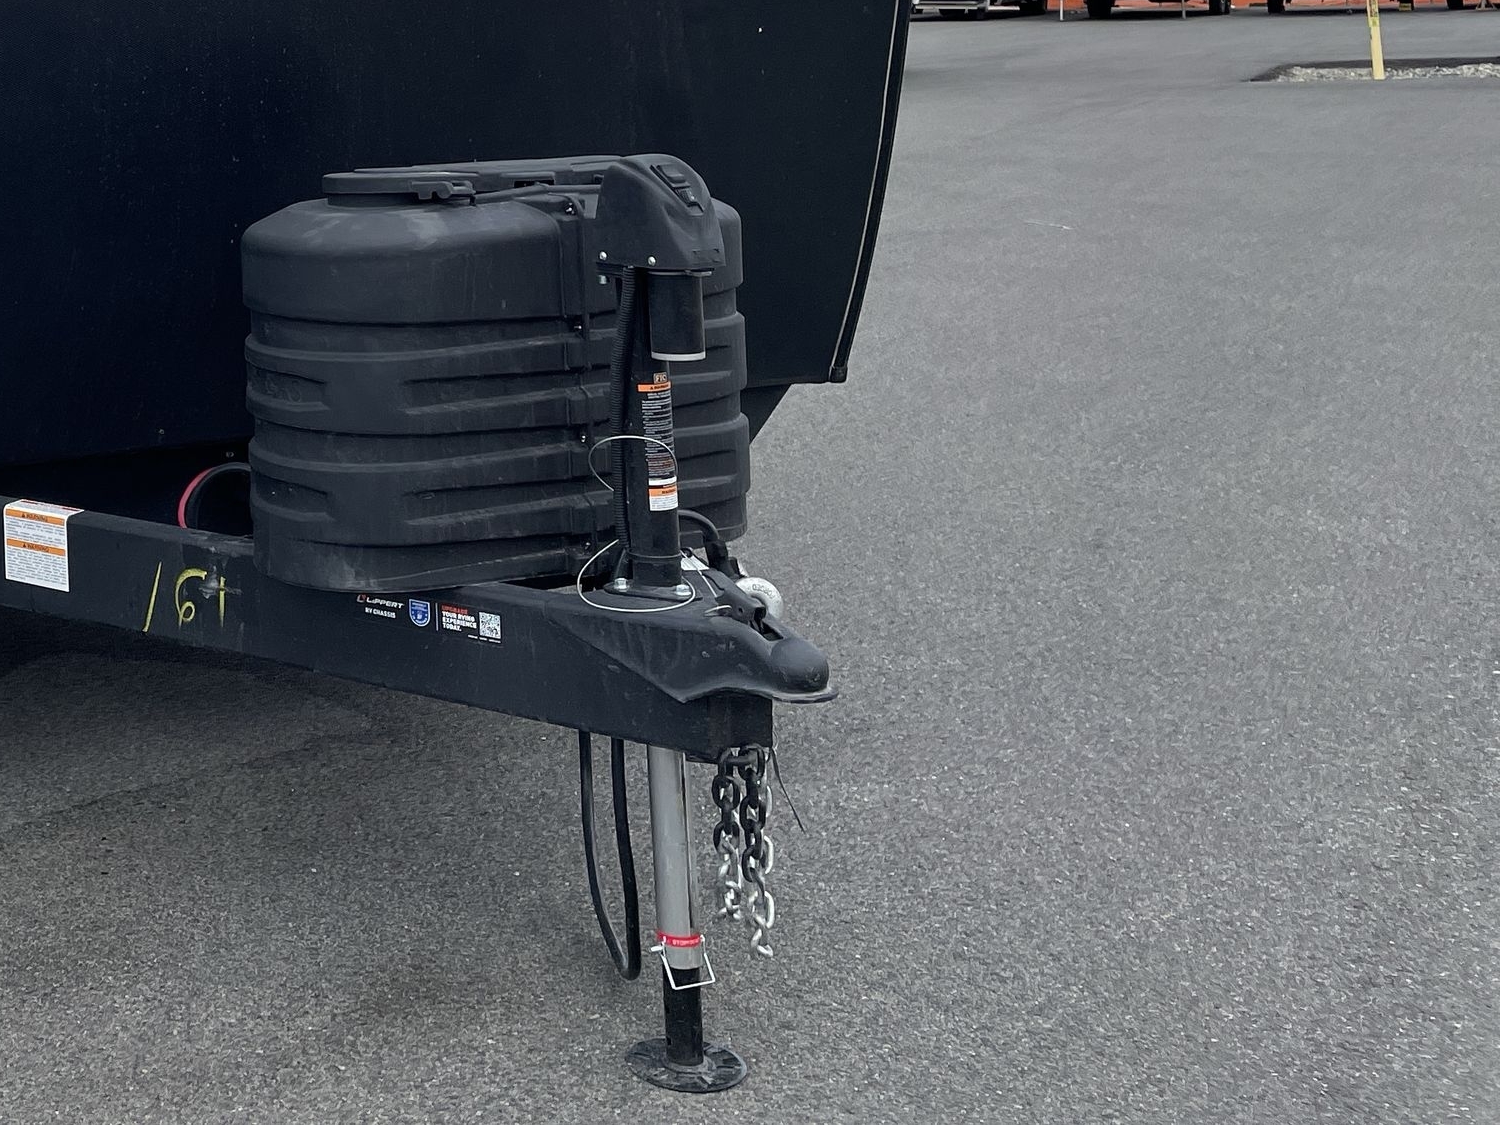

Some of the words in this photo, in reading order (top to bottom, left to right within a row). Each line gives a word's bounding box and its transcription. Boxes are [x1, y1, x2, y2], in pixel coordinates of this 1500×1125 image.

[366, 597, 404, 608] LIPPERT
[372, 608, 396, 619] CHASSIS
[442, 617, 477, 629] EXPERIENCE
